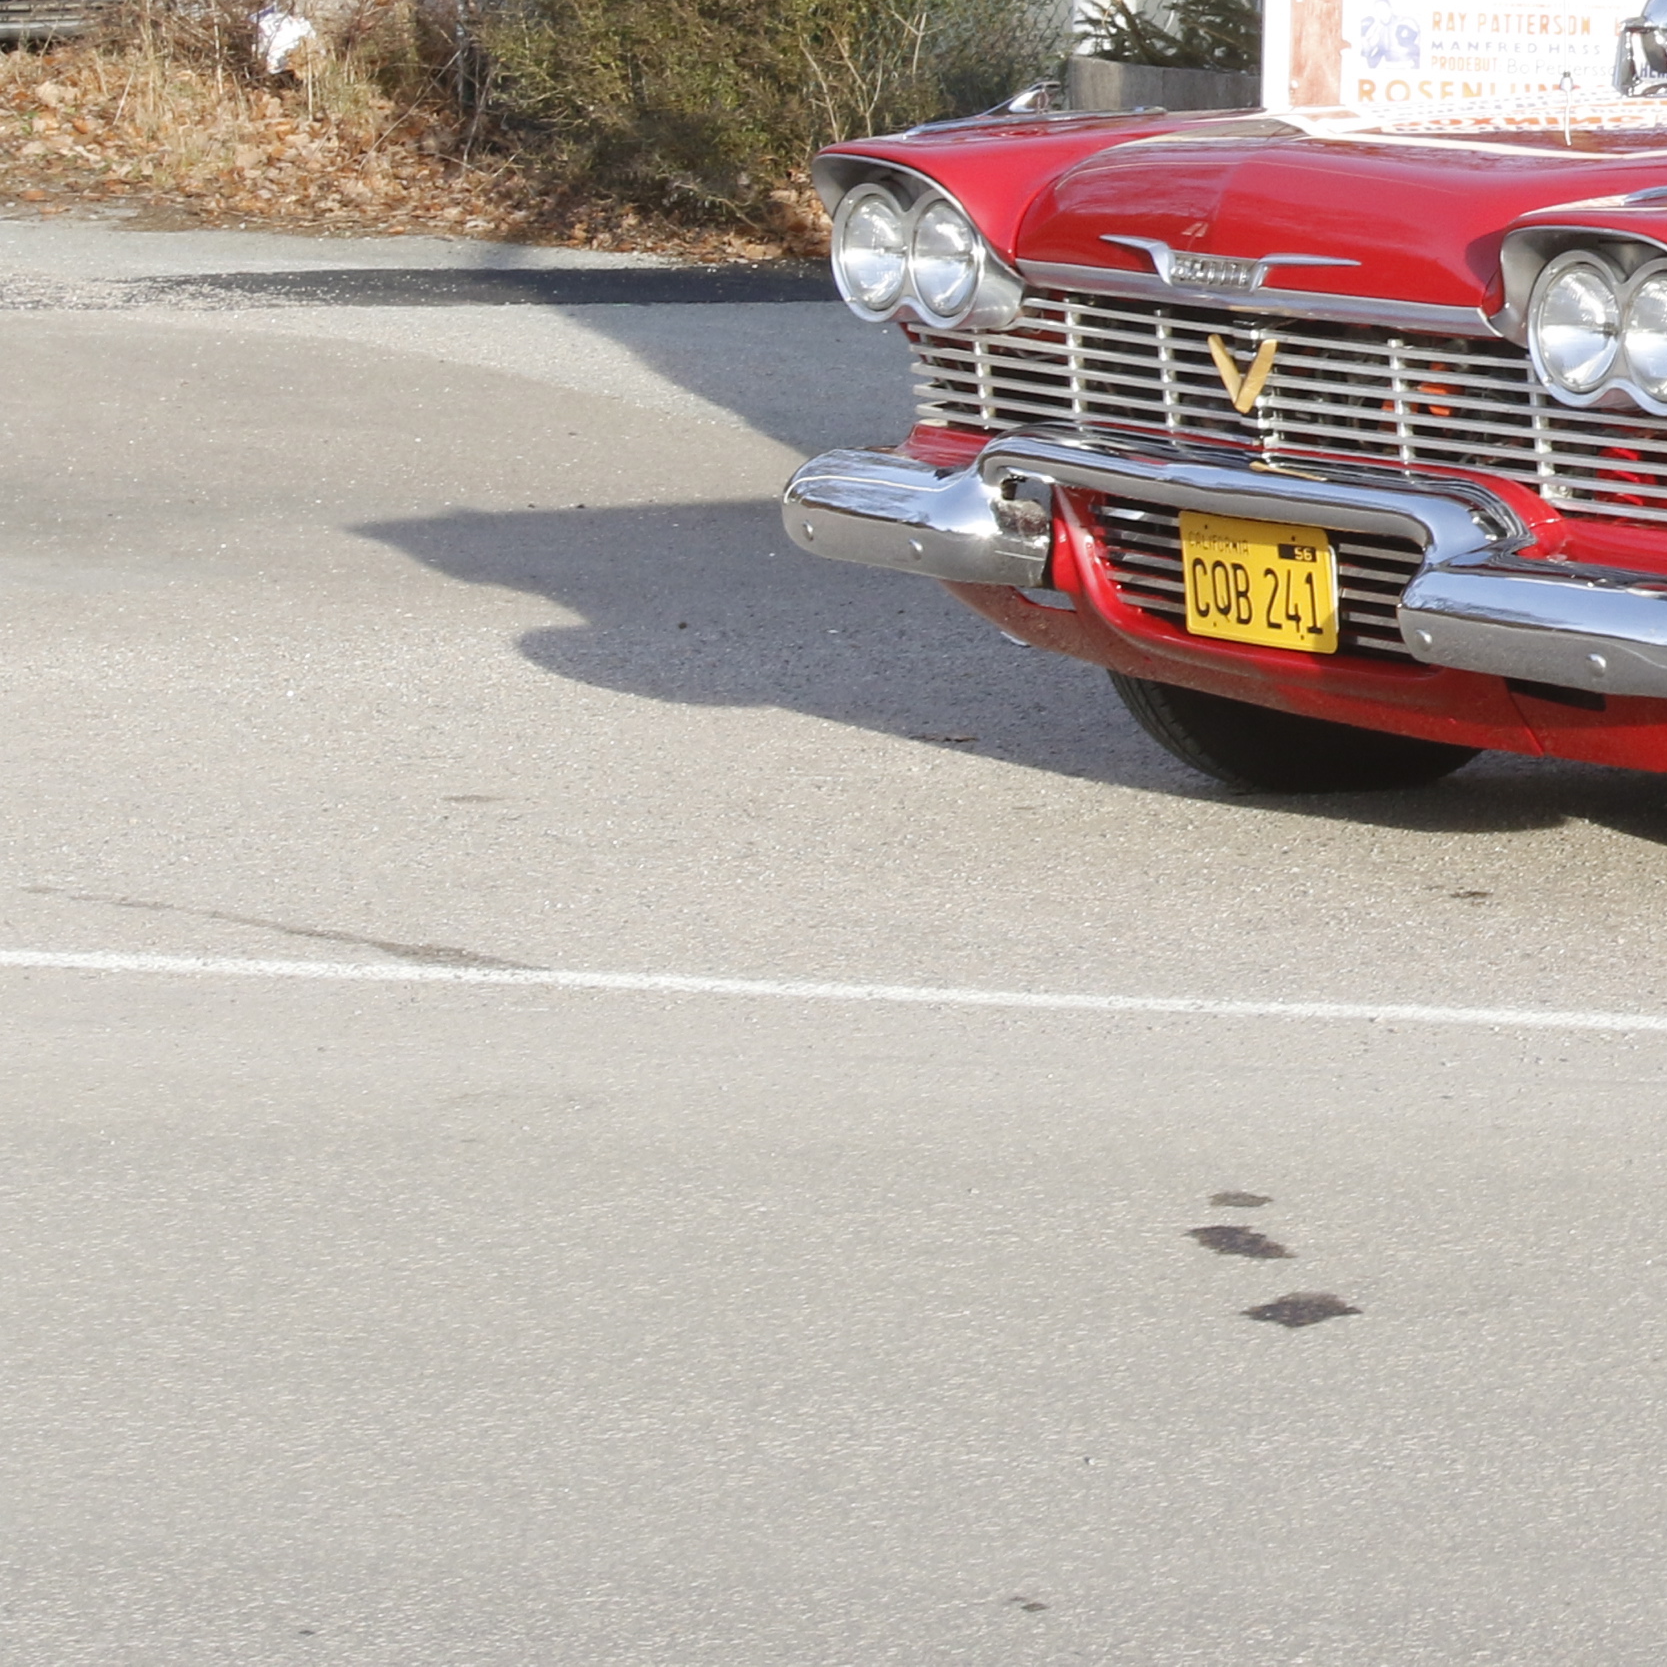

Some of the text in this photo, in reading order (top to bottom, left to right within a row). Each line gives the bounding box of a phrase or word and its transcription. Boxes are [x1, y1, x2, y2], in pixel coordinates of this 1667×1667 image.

[1431, 11, 1468, 33] RAY
[1477, 13, 1591, 37] PATTERSON
[1431, 40, 1538, 54] MANFRED
[1507, 58, 1529, 75] Bo
[1294, 546, 1313, 562] 56
[1263, 567, 1324, 634] 241
